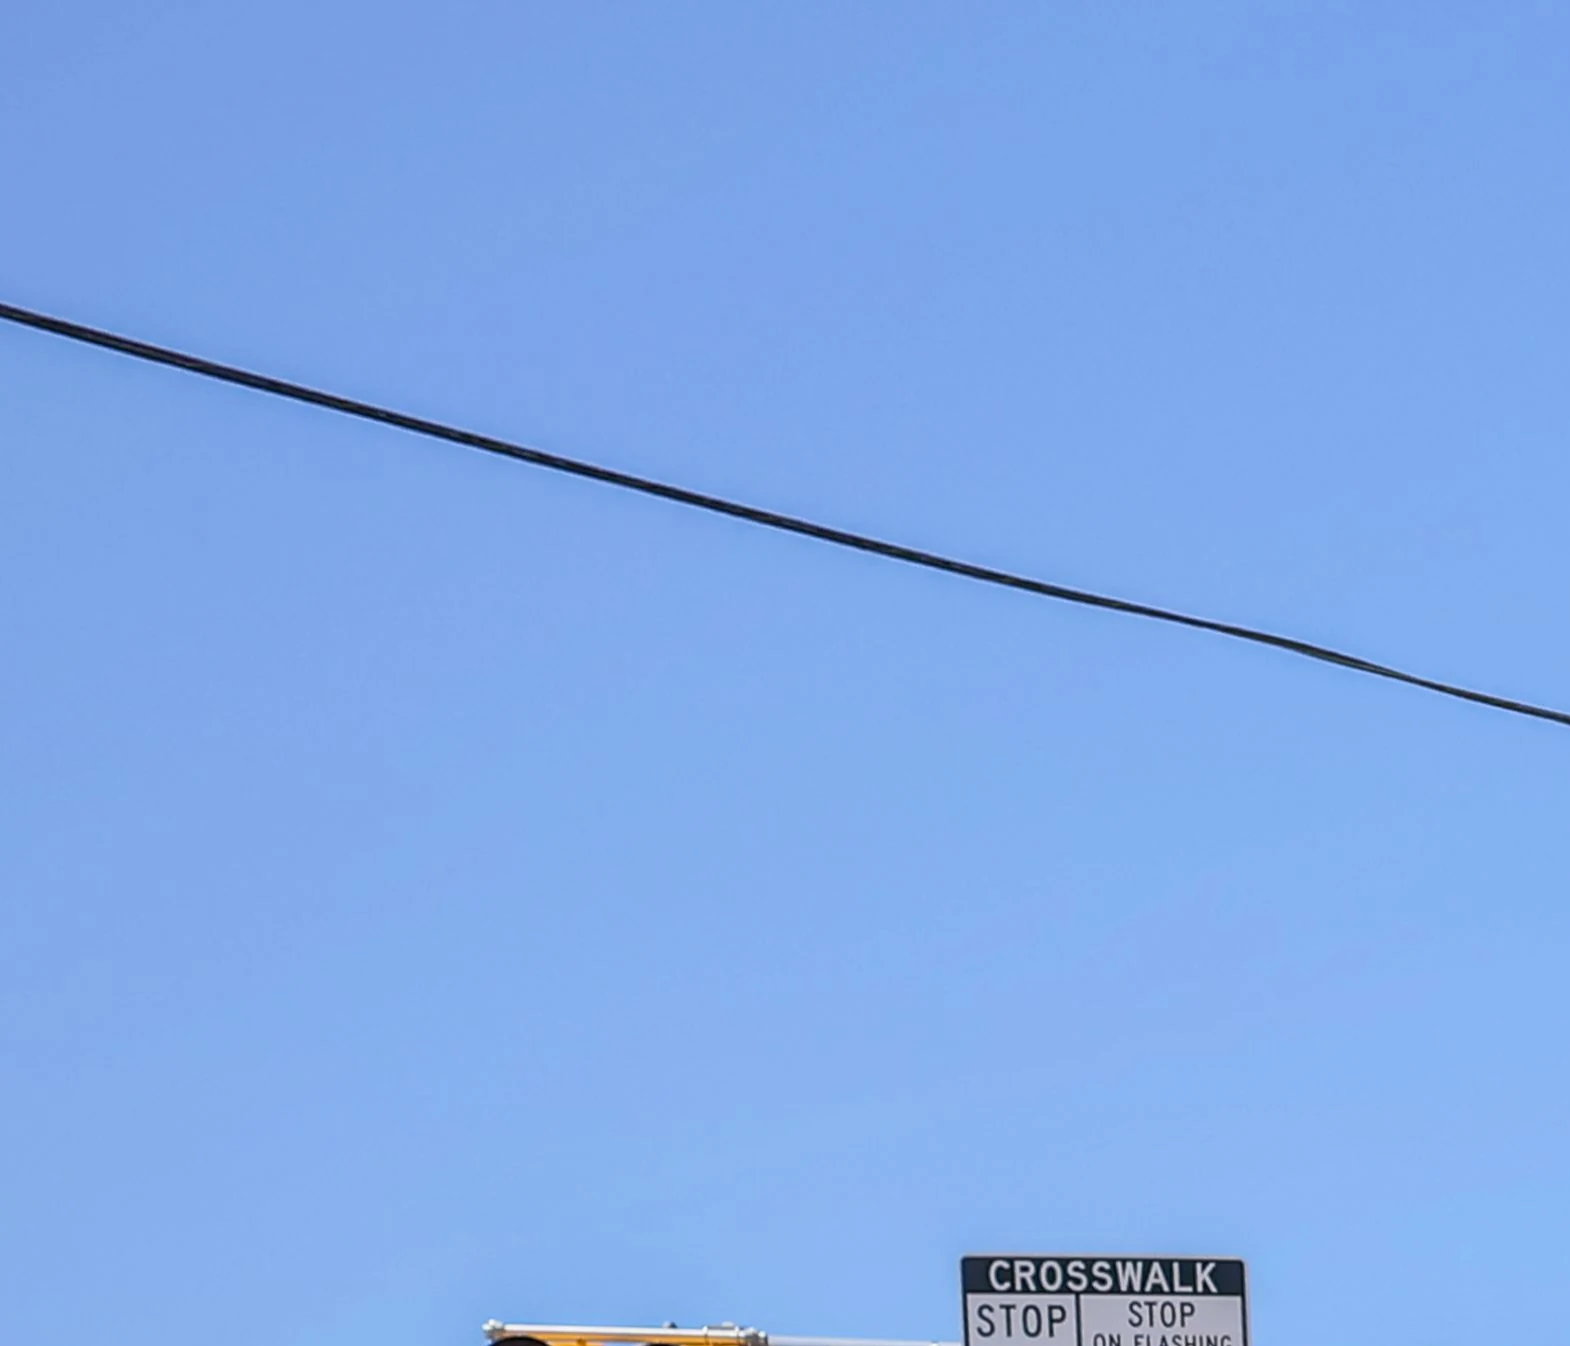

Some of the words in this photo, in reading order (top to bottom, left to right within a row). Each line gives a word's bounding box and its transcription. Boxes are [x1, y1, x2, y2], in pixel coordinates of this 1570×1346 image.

[988, 1260, 1218, 1293] CROSSWALK
[976, 1303, 1067, 1338] STOP
[1128, 1301, 1196, 1328] STOP
